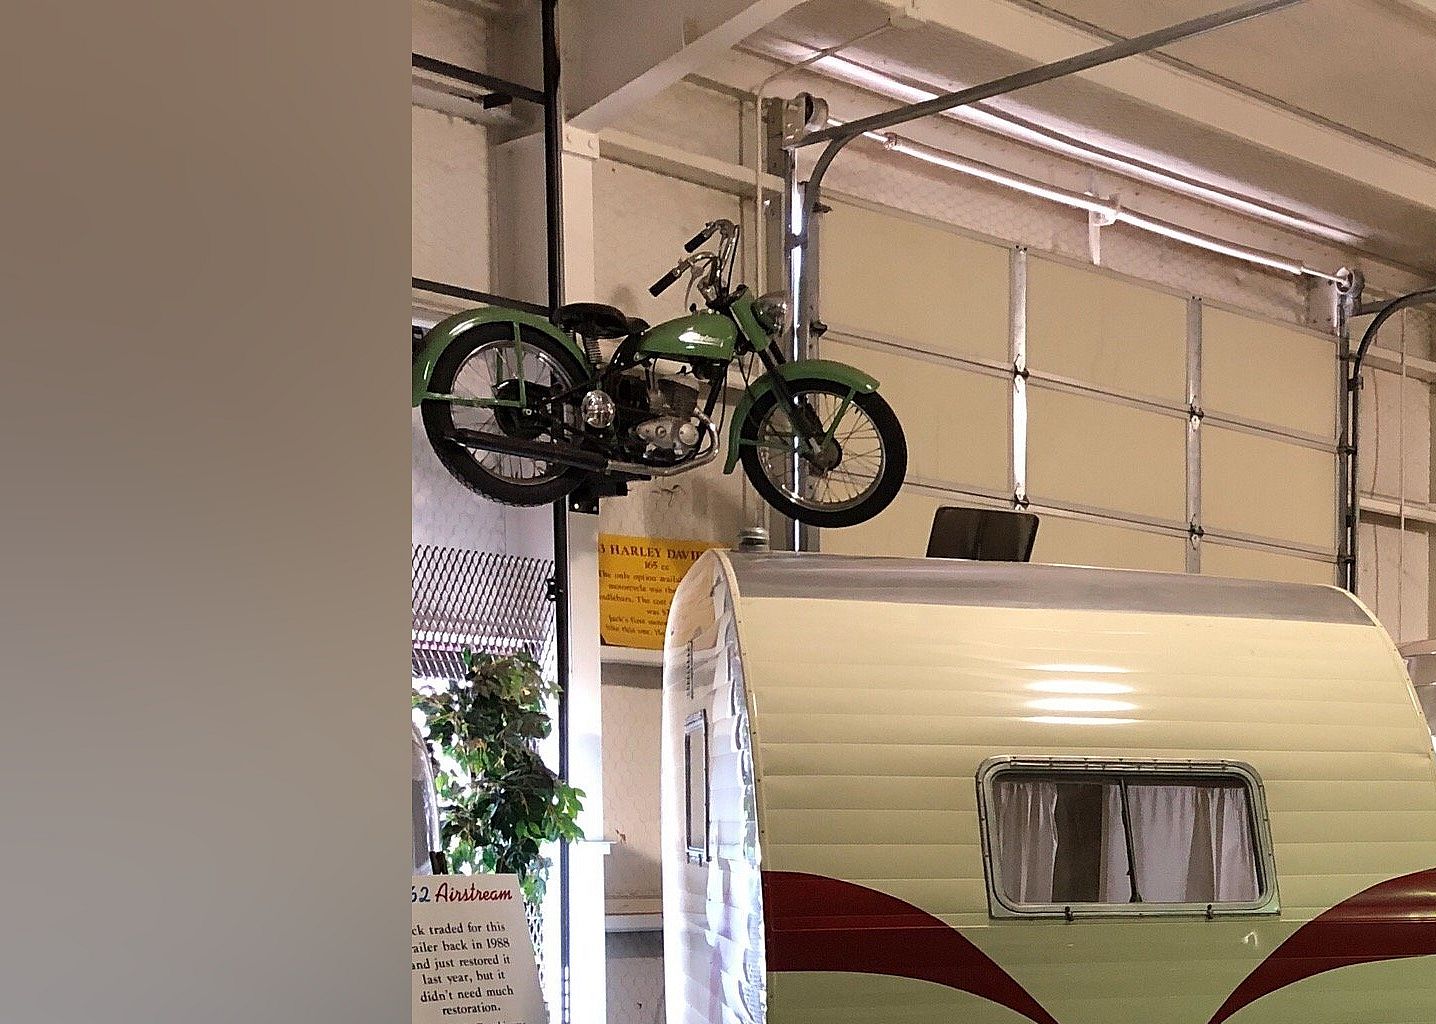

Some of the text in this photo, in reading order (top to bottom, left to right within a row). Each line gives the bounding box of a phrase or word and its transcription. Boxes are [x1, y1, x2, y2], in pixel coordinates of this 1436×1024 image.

[610, 544, 662, 558] HARLEY
[644, 560, 658, 569] 165
[435, 882, 513, 903] Airstream
[430, 922, 463, 935] traded
[468, 921, 482, 933] for
[486, 921, 506, 932] this
[443, 940, 468, 951] back
[472, 939, 482, 949] in
[487, 938, 510, 949] 1988
[412, 954, 511, 971] and just restored it
[422, 969, 506, 985] last year, but it
[420, 985, 514, 1003] didn't need much
[442, 1002, 501, 1016] restoration.
